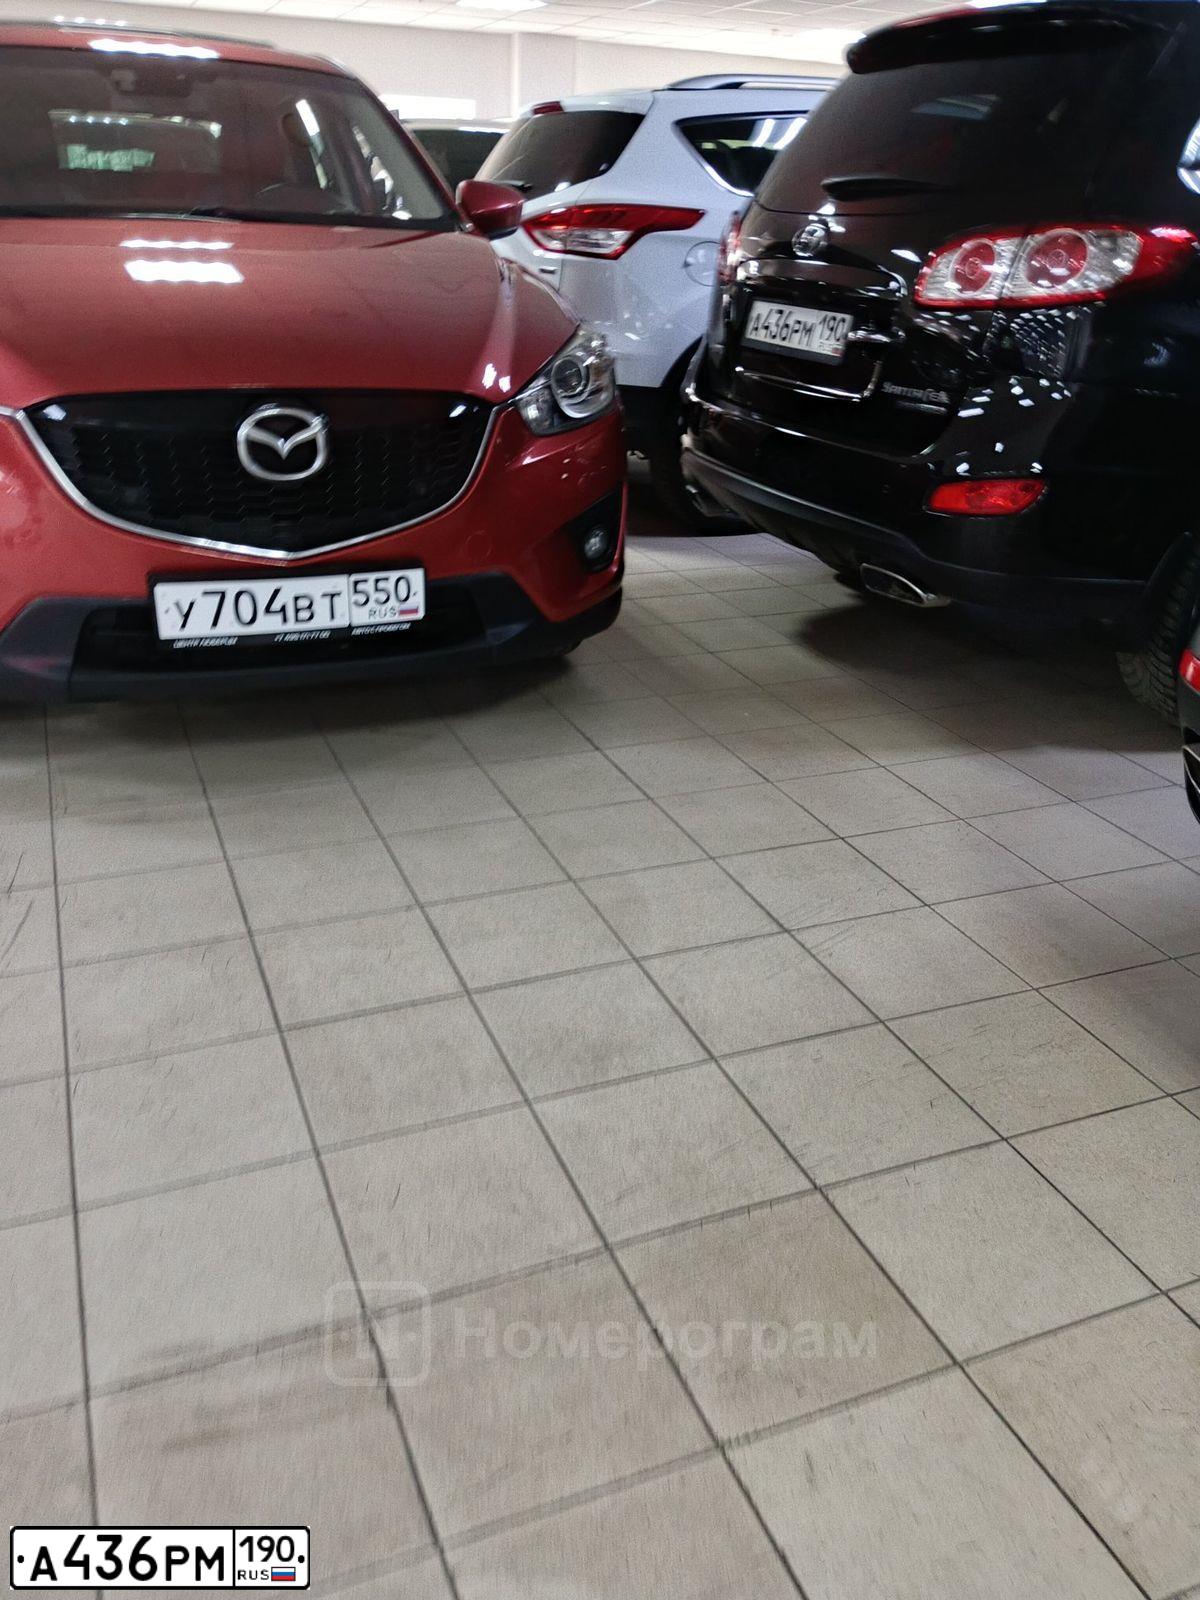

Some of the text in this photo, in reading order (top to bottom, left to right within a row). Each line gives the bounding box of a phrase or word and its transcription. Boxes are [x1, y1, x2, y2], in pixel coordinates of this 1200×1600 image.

[749, 308, 846, 347] А436РМ 190
[174, 576, 411, 633] У704ВТ 550
[368, 606, 397, 620] RUS
